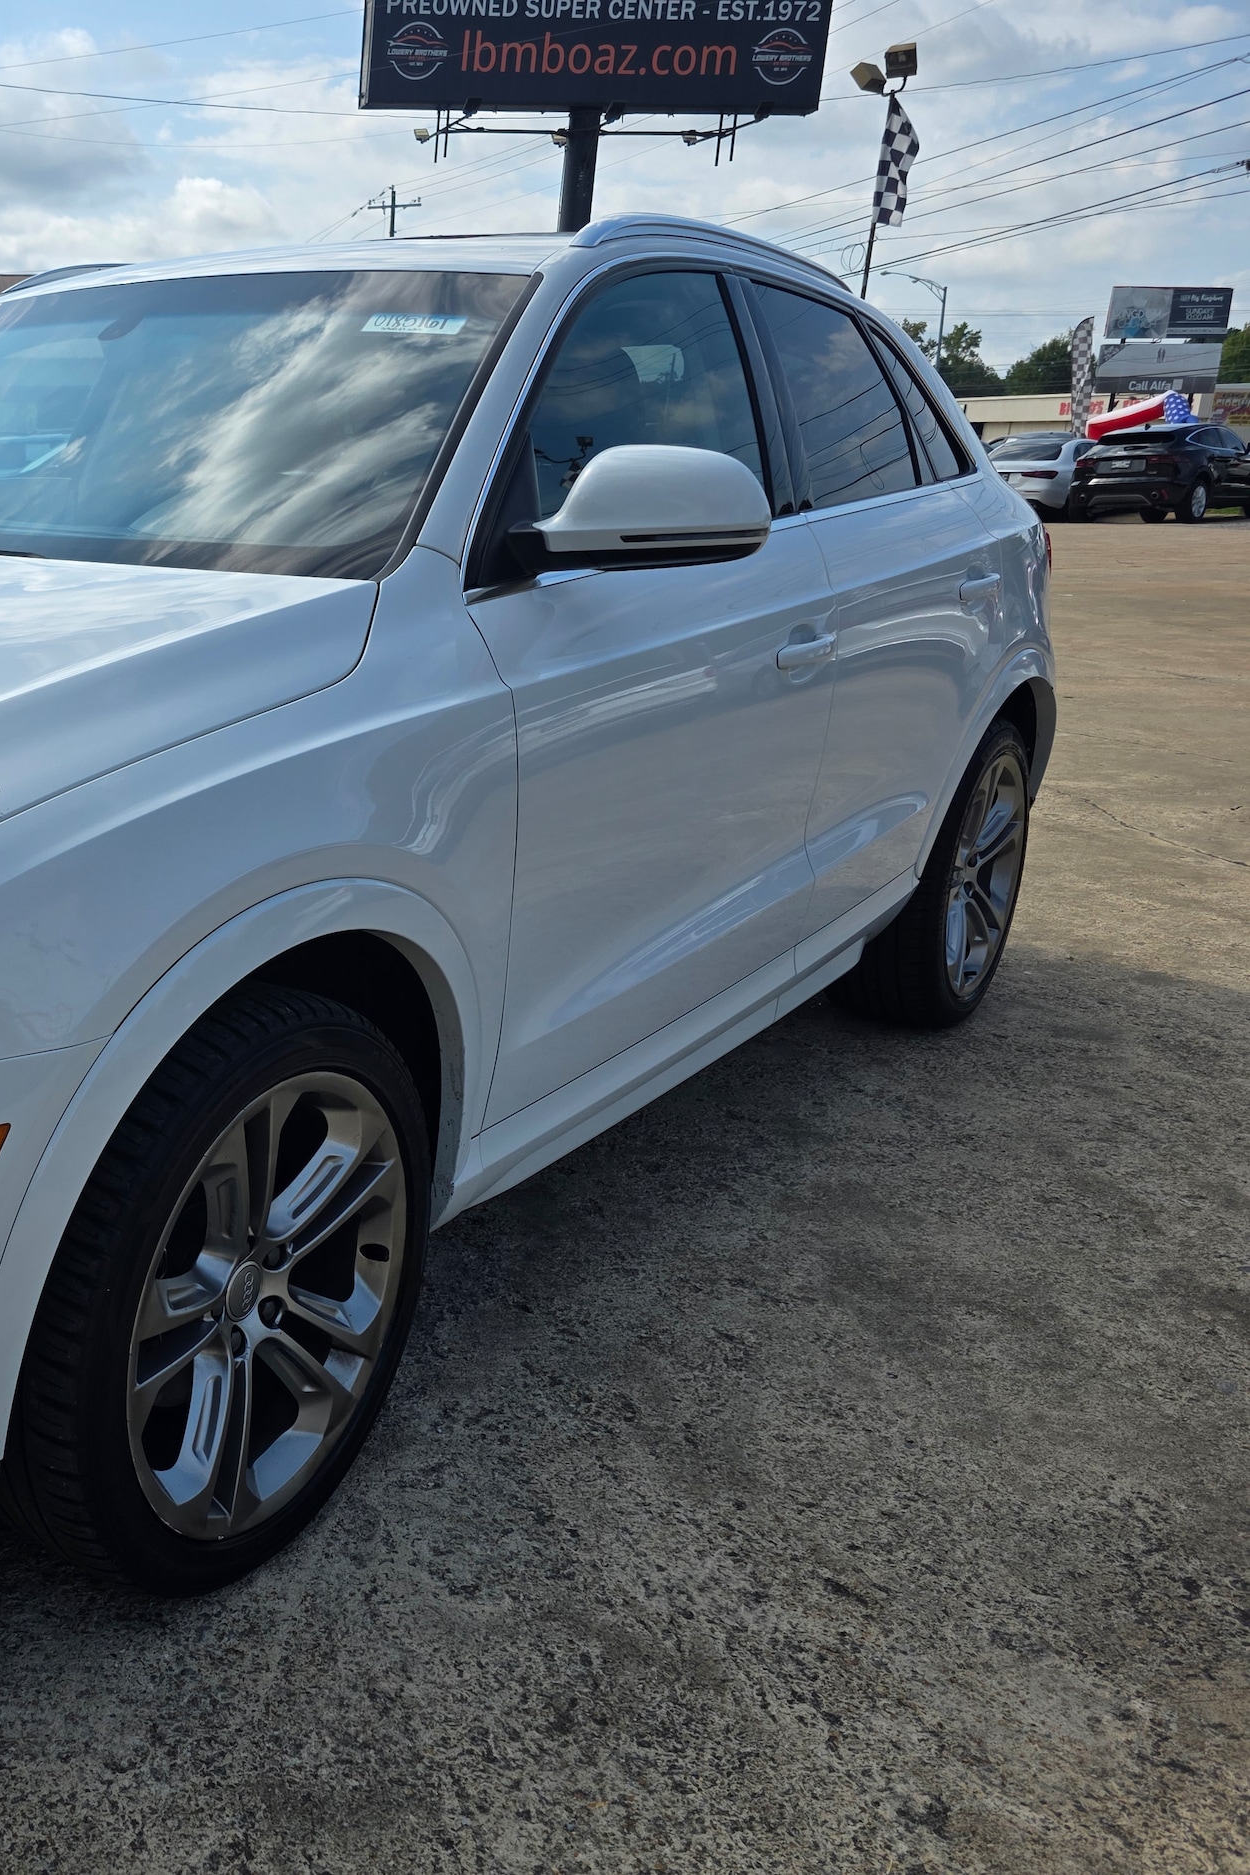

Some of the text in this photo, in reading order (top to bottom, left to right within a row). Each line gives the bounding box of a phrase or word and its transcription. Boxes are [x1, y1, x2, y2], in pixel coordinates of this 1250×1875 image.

[386, 0, 518, 17] PREOWNED
[524, 0, 600, 19] SUPER
[607, 0, 696, 21] CENTER
[716, 0, 823, 22] EST.1972
[460, 29, 738, 76] lbmboaz.com
[1117, 320, 1157, 328] CHURCH
[1128, 380, 1172, 391] Call Alfa
